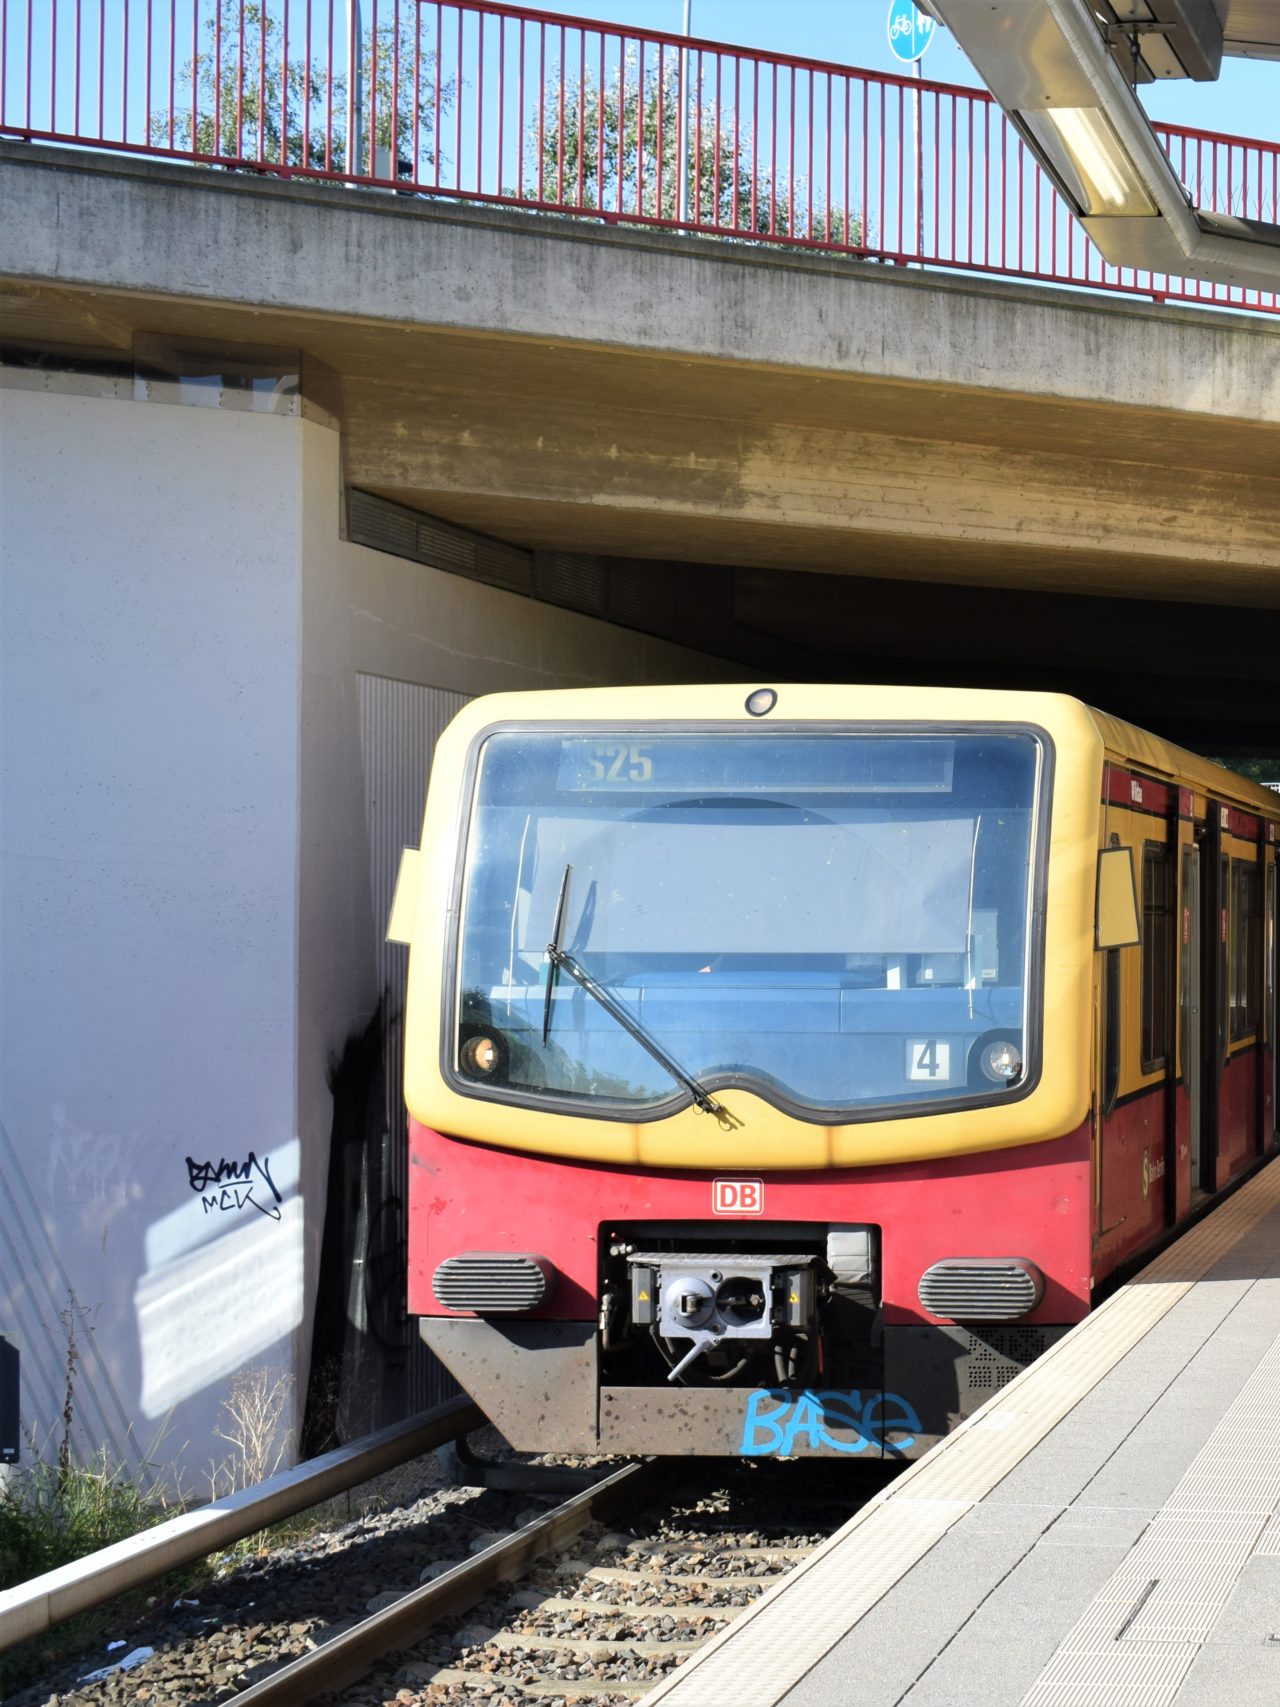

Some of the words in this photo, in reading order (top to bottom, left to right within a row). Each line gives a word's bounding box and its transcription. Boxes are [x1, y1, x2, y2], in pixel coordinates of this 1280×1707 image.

[584, 744, 653, 783] S25
[916, 1039, 940, 1077] 4
[719, 1183, 758, 1208] DB
